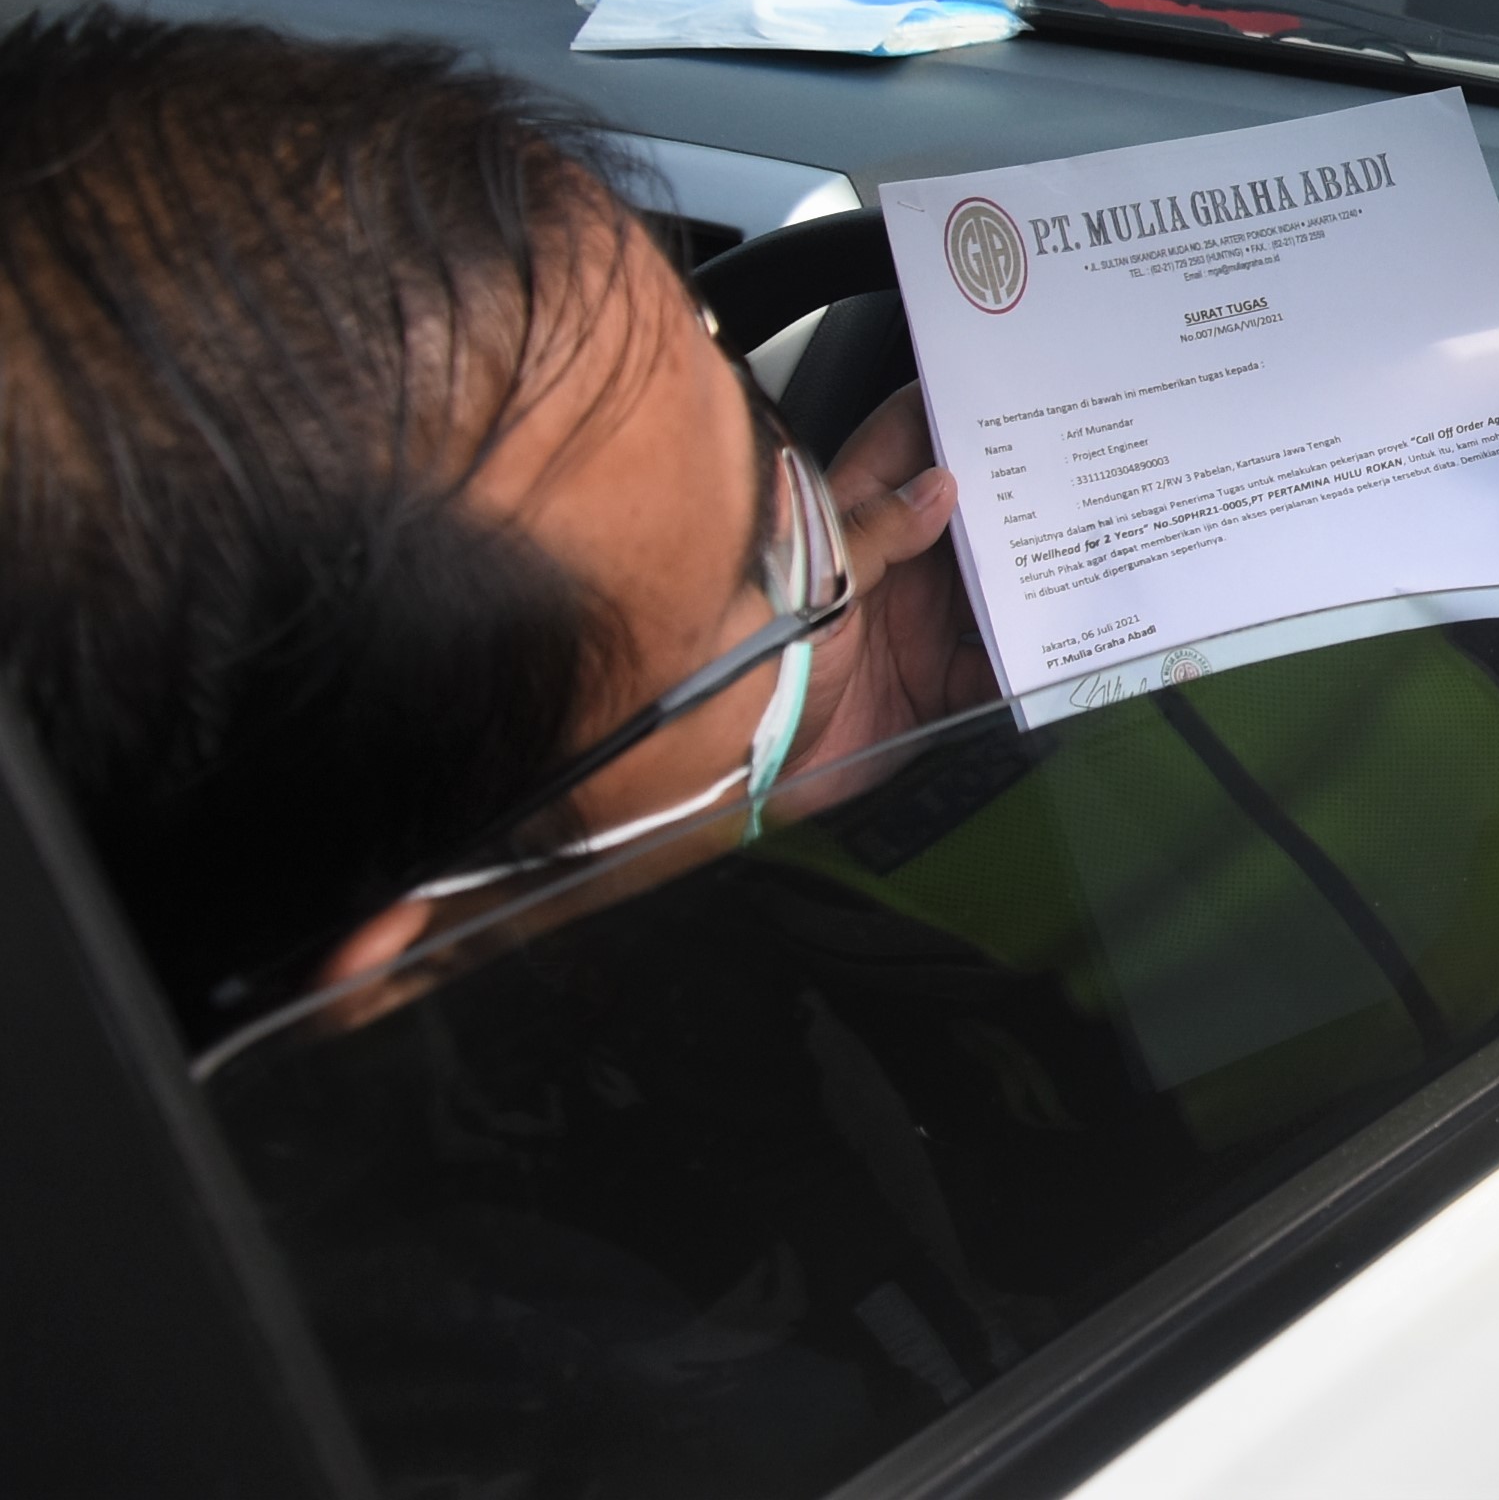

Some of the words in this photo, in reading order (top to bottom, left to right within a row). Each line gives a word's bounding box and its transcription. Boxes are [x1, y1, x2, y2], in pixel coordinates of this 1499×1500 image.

[1028, 215, 1081, 255] P.T.
[1081, 196, 1190, 248] MULIA
[1190, 176, 1298, 227] GRAHA
[1299, 152, 1396, 206] ABADI
[1100, 257, 1129, 270] SULTAN
[1130, 250, 1167, 265] ISKANDAR
[1220, 233, 1245, 246] ARTERI
[1246, 226, 1277, 241] PONDOK
[1278, 222, 1300, 234] INDAH
[1306, 214, 1338, 228] JAKARTA
[1206, 247, 1244, 265] (HUNTING)
[1184, 269, 1203, 283] Email
[1180, 313, 1284, 343] No.007/MGA/VII/2021
[1184, 306, 1223, 324] SURAT
[1226, 297, 1268, 315] TUGAS
[977, 417, 1001, 430] Yang
[1002, 407, 1045, 424] bertanda
[1046, 402, 1079, 418] tangan
[1080, 398, 1090, 410] di
[1091, 392, 1123, 407] bawah
[1124, 388, 1137, 399] ini
[1138, 376, 1197, 397] memberikan
[1198, 371, 1224, 382] tugas
[1225, 361, 1259, 377] kepada
[1066, 427, 1084, 441] Arif
[1085, 417, 1134, 437] Munandar
[985, 443, 1013, 456] Nama
[1072, 447, 1106, 464] Project
[1107, 438, 1149, 456] Engineer
[990, 464, 1027, 480] Jabatan
[1009, 530, 1064, 550] Selanjutnya
[1067, 522, 1096, 537] dalam
[1098, 516, 1114, 528] hal
[1116, 513, 1129, 524] ini
[1131, 503, 1168, 521] sebagai
[1169, 491, 1216, 510] Penerima
[1218, 483, 1246, 498] Tugas
[1247, 476, 1276, 490] untuk
[1277, 462, 1328, 480] melakukan
[1329, 450, 1376, 468] pekerjaan
[1377, 440, 1409, 457] proyek
[1437, 426, 1455, 440] Off
[1456, 420, 1484, 435] Order
[1082, 489, 1140, 509] Mendungan
[1141, 483, 1154, 494] RT
[1155, 475, 1183, 492] 2/RW
[1193, 465, 1236, 482] Pabelan,
[1236, 451, 1281, 469] Kartasura
[1282, 445, 1306, 458] Jawa
[1307, 436, 1342, 451] Tengah
[997, 491, 1014, 503] NIK
[1014, 555, 1029, 568] Of
[1031, 543, 1081, 563] Wellhead
[1083, 538, 1100, 553] for
[1268, 475, 1331, 500] PERTAMINA
[1333, 467, 1362, 482] HULU
[1365, 457, 1407, 475] ROKAN,
[1408, 449, 1437, 463] Untuk
[1456, 437, 1480, 451] kami
[1003, 510, 1037, 525] Alamat
[1019, 568, 1056, 584] seluruh
[1057, 560, 1085, 575] Pihak
[1086, 555, 1108, 568] agar
[1110, 544, 1139, 561] dapat
[1140, 527, 1202, 550] memberikan
[1203, 521, 1219, 534] ijin
[1220, 517, 1240, 528] dan
[1241, 509, 1268, 524] akses
[1269, 495, 1319, 516] perjalanan
[1320, 485, 1355, 503] kepada
[1356, 477, 1391, 495] pekerja
[1392, 466, 1432, 483] tersebut
[1024, 589, 1037, 601] ini
[1038, 581, 1071, 598] dibuat
[1072, 573, 1101, 590] untuk
[1102, 551, 1170, 581] dipergunakan
[1171, 534, 1228, 558] seperlunya.
[1042, 637, 1081, 655] Jakarta,
[1081, 630, 1095, 641] 06
[1097, 622, 1114, 636] Juli
[1115, 614, 1140, 630] 2021
[1046, 649, 1092, 669] PT.Mulia
[1094, 637, 1125, 653] Graha
[1127, 624, 1157, 641] Abadi
